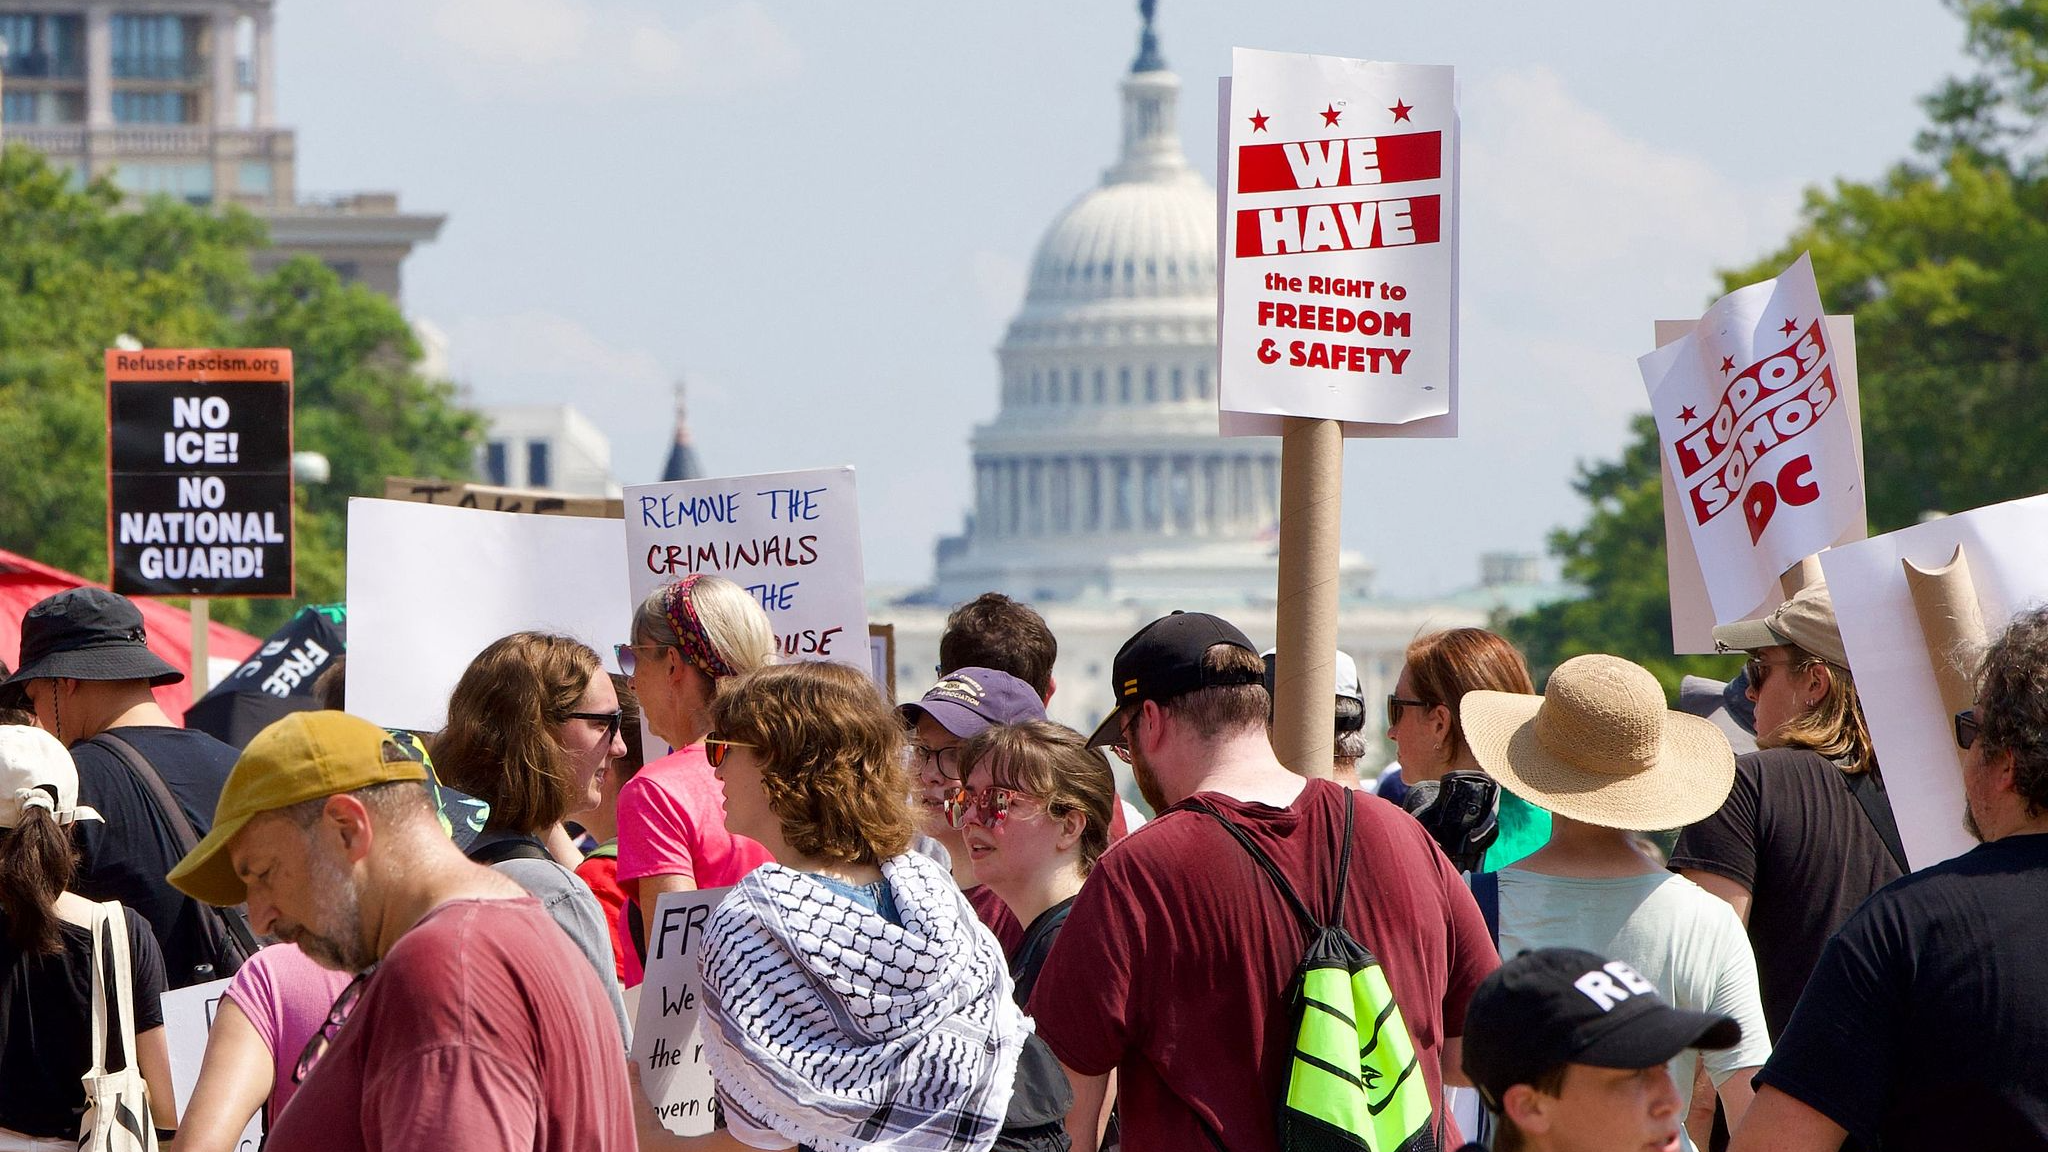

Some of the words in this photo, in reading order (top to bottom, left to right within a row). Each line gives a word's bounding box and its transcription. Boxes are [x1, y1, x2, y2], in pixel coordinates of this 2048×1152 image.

[1282, 137, 1382, 189] WE
[1258, 199, 1416, 255] HAVE
[1264, 272, 1302, 293] the
[1308, 275, 1374, 300] RIGHT
[1380, 281, 1407, 301] to
[1258, 301, 1411, 337] FREEDOM
[117, 355, 280, 374] RefuseFascism.org
[1257, 338, 1281, 365] &
[1289, 341, 1411, 375] SAFETY
[172, 396, 230, 429] NO
[1683, 332, 1820, 466] TODOS
[164, 432, 239, 464] ICE!
[1699, 376, 1832, 516] SOMOS
[178, 476, 226, 509] NO
[639, 492, 741, 529] REMOVE
[757, 487, 827, 523] THE
[1743, 454, 1820, 547] DC
[119, 512, 284, 545] NATIONAL
[139, 546, 264, 580] GUARD!
[647, 535, 818, 575] CRIMINALS
[261, 637, 330, 699] FREE
[662, 983, 694, 1017] We
[649, 1038, 681, 1070] the
